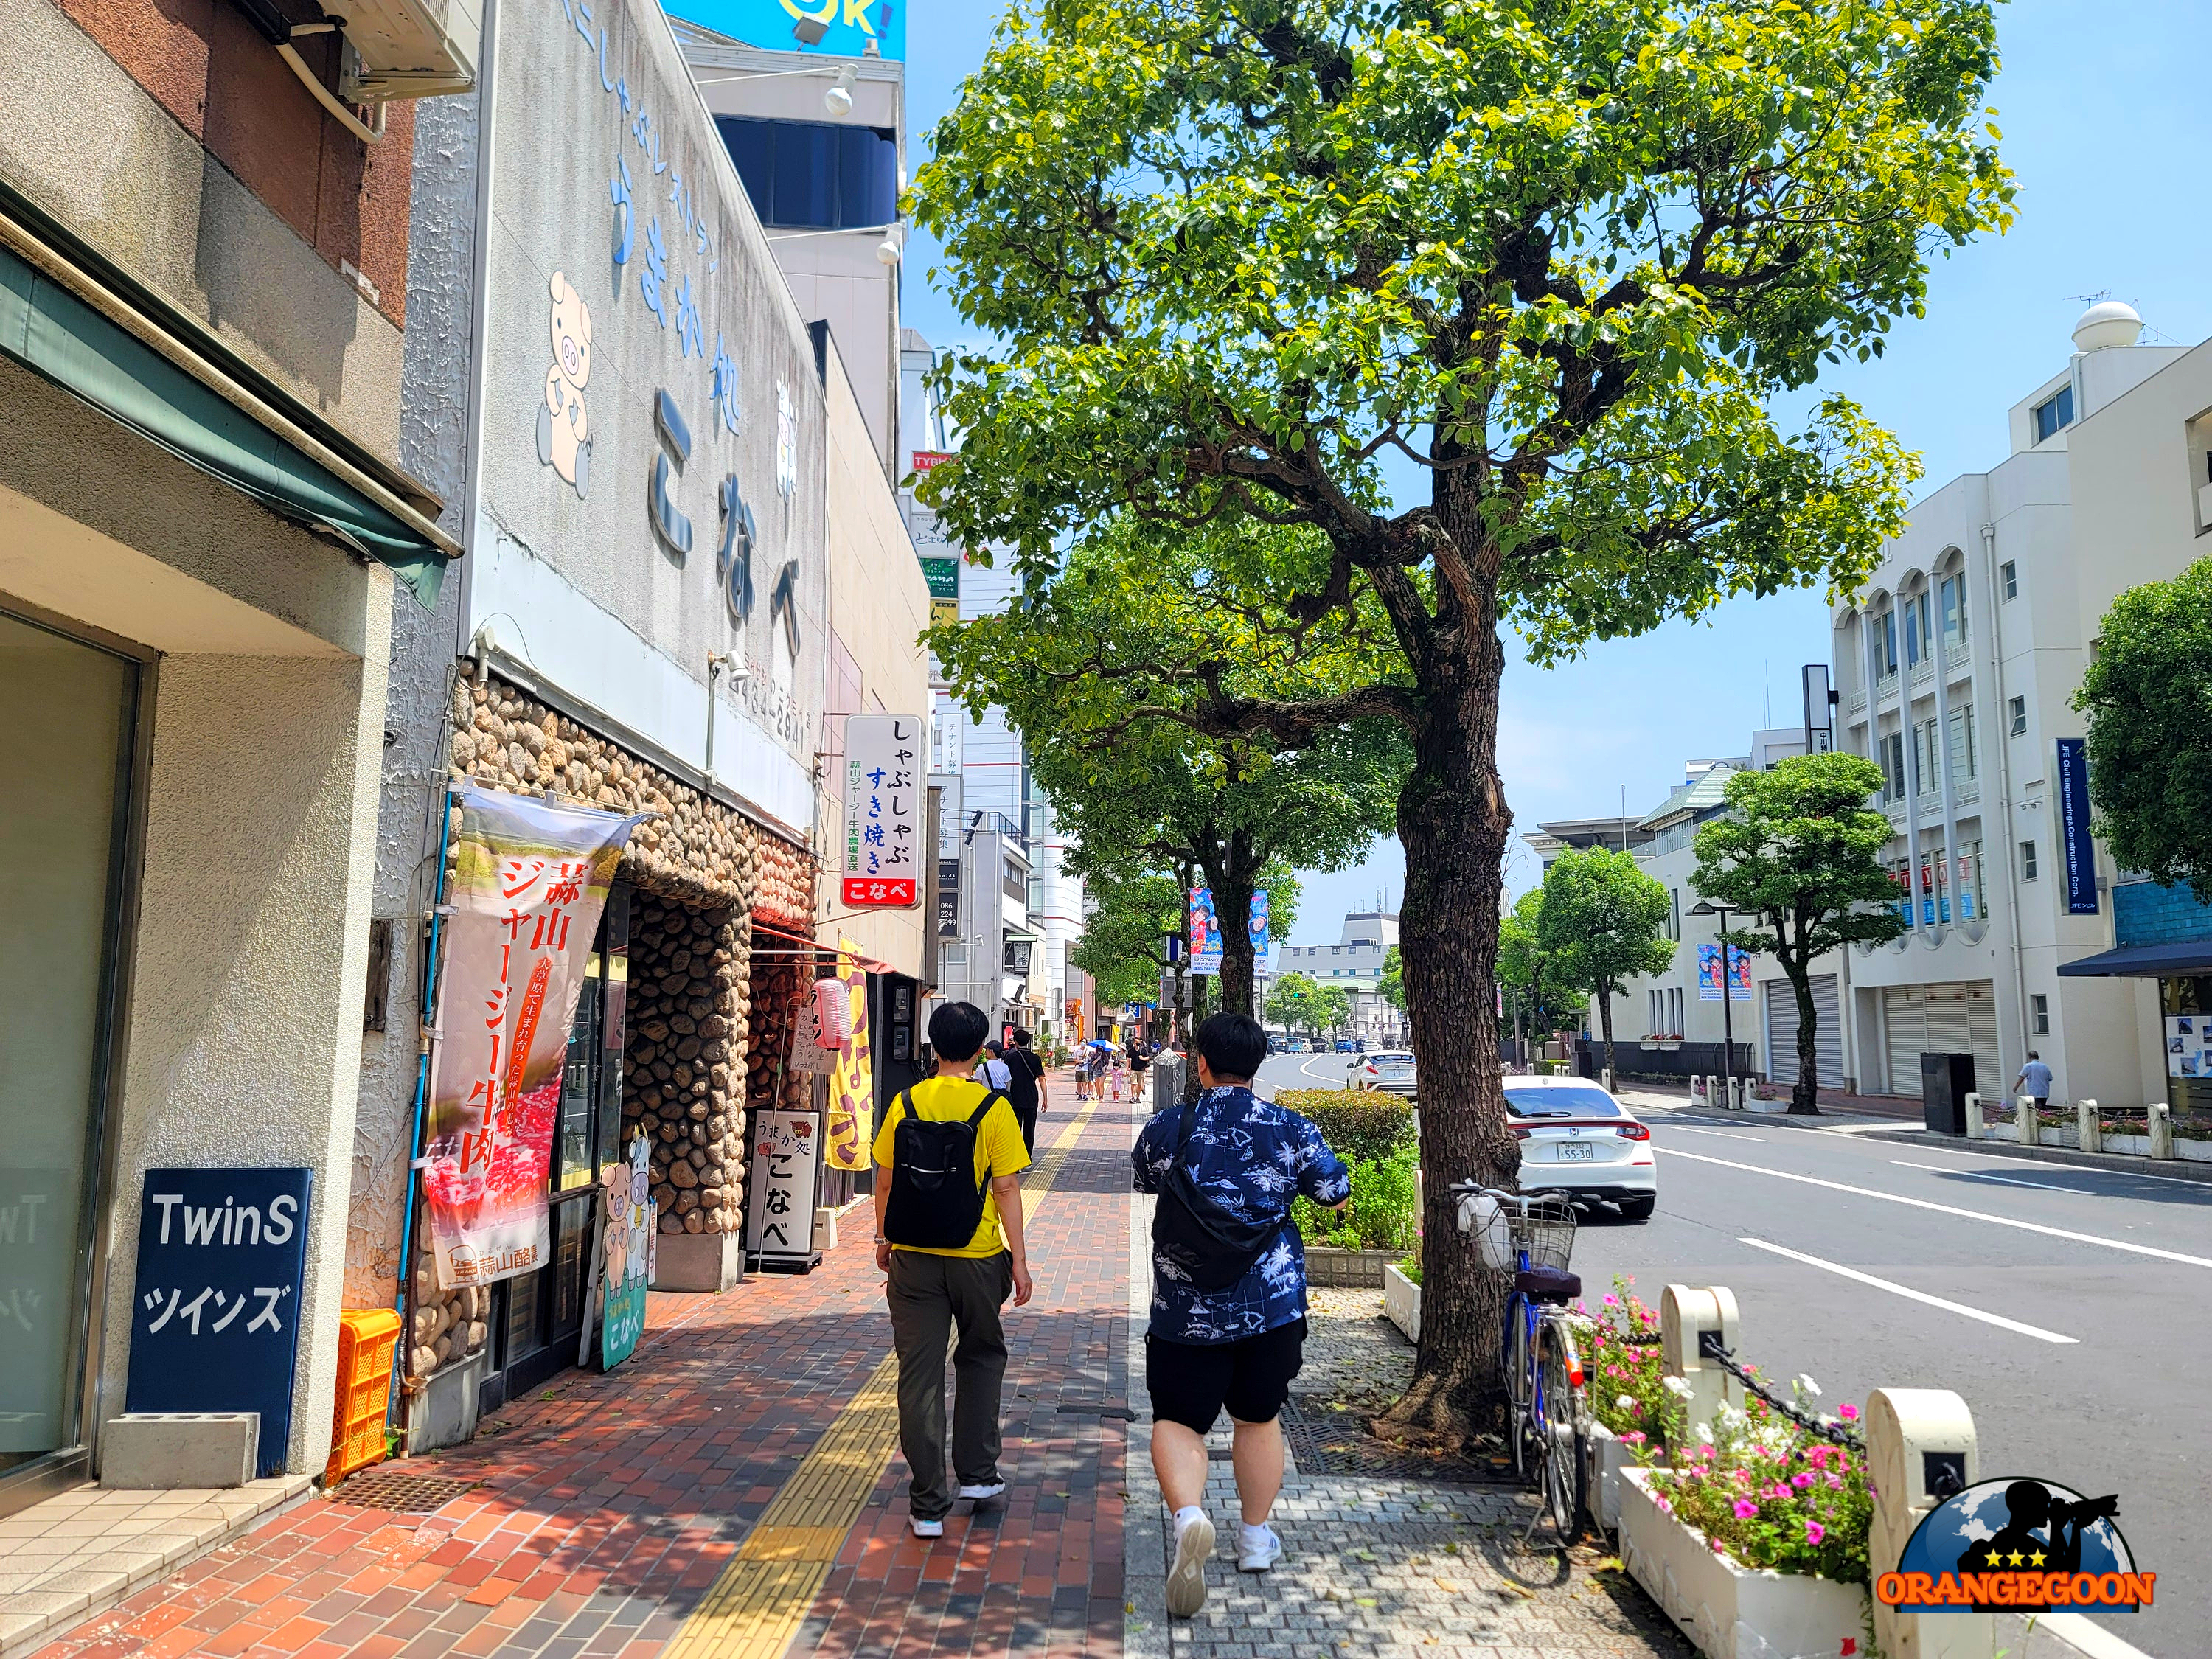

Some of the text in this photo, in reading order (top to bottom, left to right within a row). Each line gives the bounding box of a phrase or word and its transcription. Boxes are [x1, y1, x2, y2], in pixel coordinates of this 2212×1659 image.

[610, 153, 740, 436] うまか処
[648, 387, 801, 656] こなべ
[1820, 732, 1829, 754] 中川特
[2062, 744, 2070, 758] JFE
[885, 720, 913, 864] しゃぶしゃぶ
[863, 766, 886, 874] すき焼き
[530, 863, 589, 951] 蒜山
[850, 882, 908, 900] こなべ
[460, 860, 544, 1175] ジャージー牛肉
[759, 1121, 810, 1155] うまか処
[1565, 1150, 1590, 1158] 55-30
[152, 1194, 298, 1245] TwinS
[762, 1154, 793, 1247] こなべ
[144, 1284, 293, 1335] ツインズ
[611, 1311, 639, 1351] こなべ
